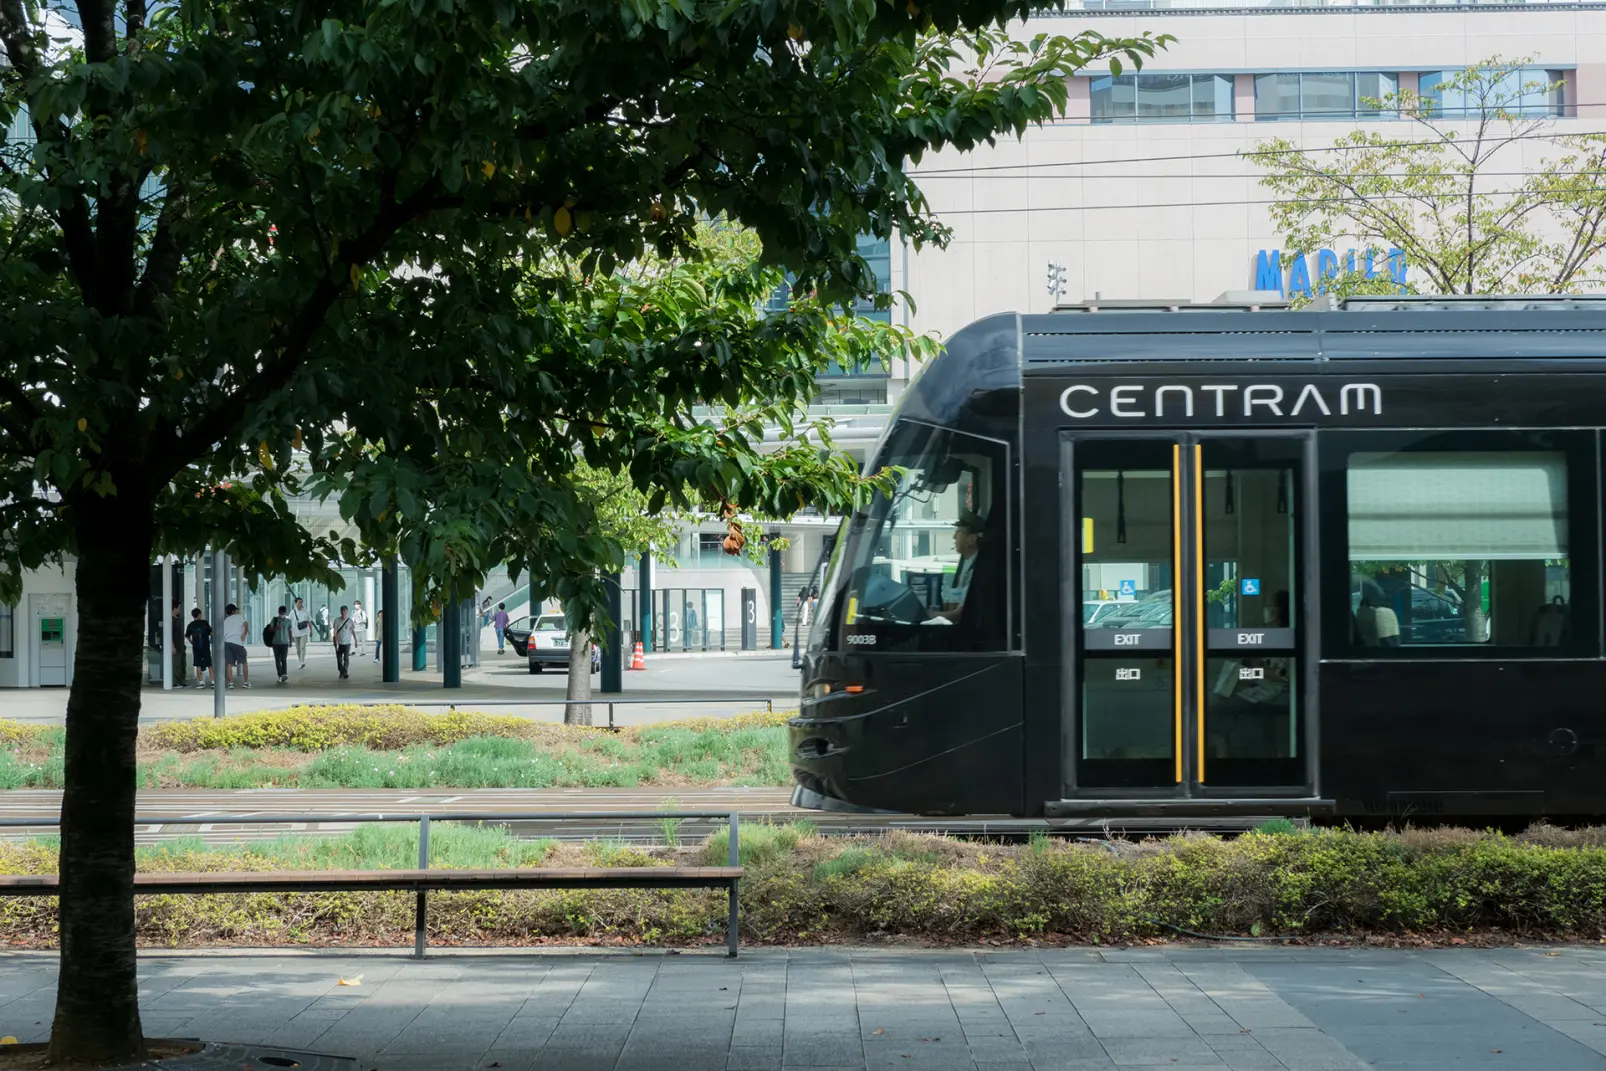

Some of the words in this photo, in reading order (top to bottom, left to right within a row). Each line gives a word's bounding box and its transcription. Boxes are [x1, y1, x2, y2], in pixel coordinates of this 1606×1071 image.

[1059, 383, 1382, 418] CENTRAM
[748, 600, 755, 624] 3
[1114, 633, 1142, 645] EXIT
[1237, 633, 1265, 645] EXIT
[1115, 668, 1141, 680] 出口
[1238, 667, 1264, 680] 出口
